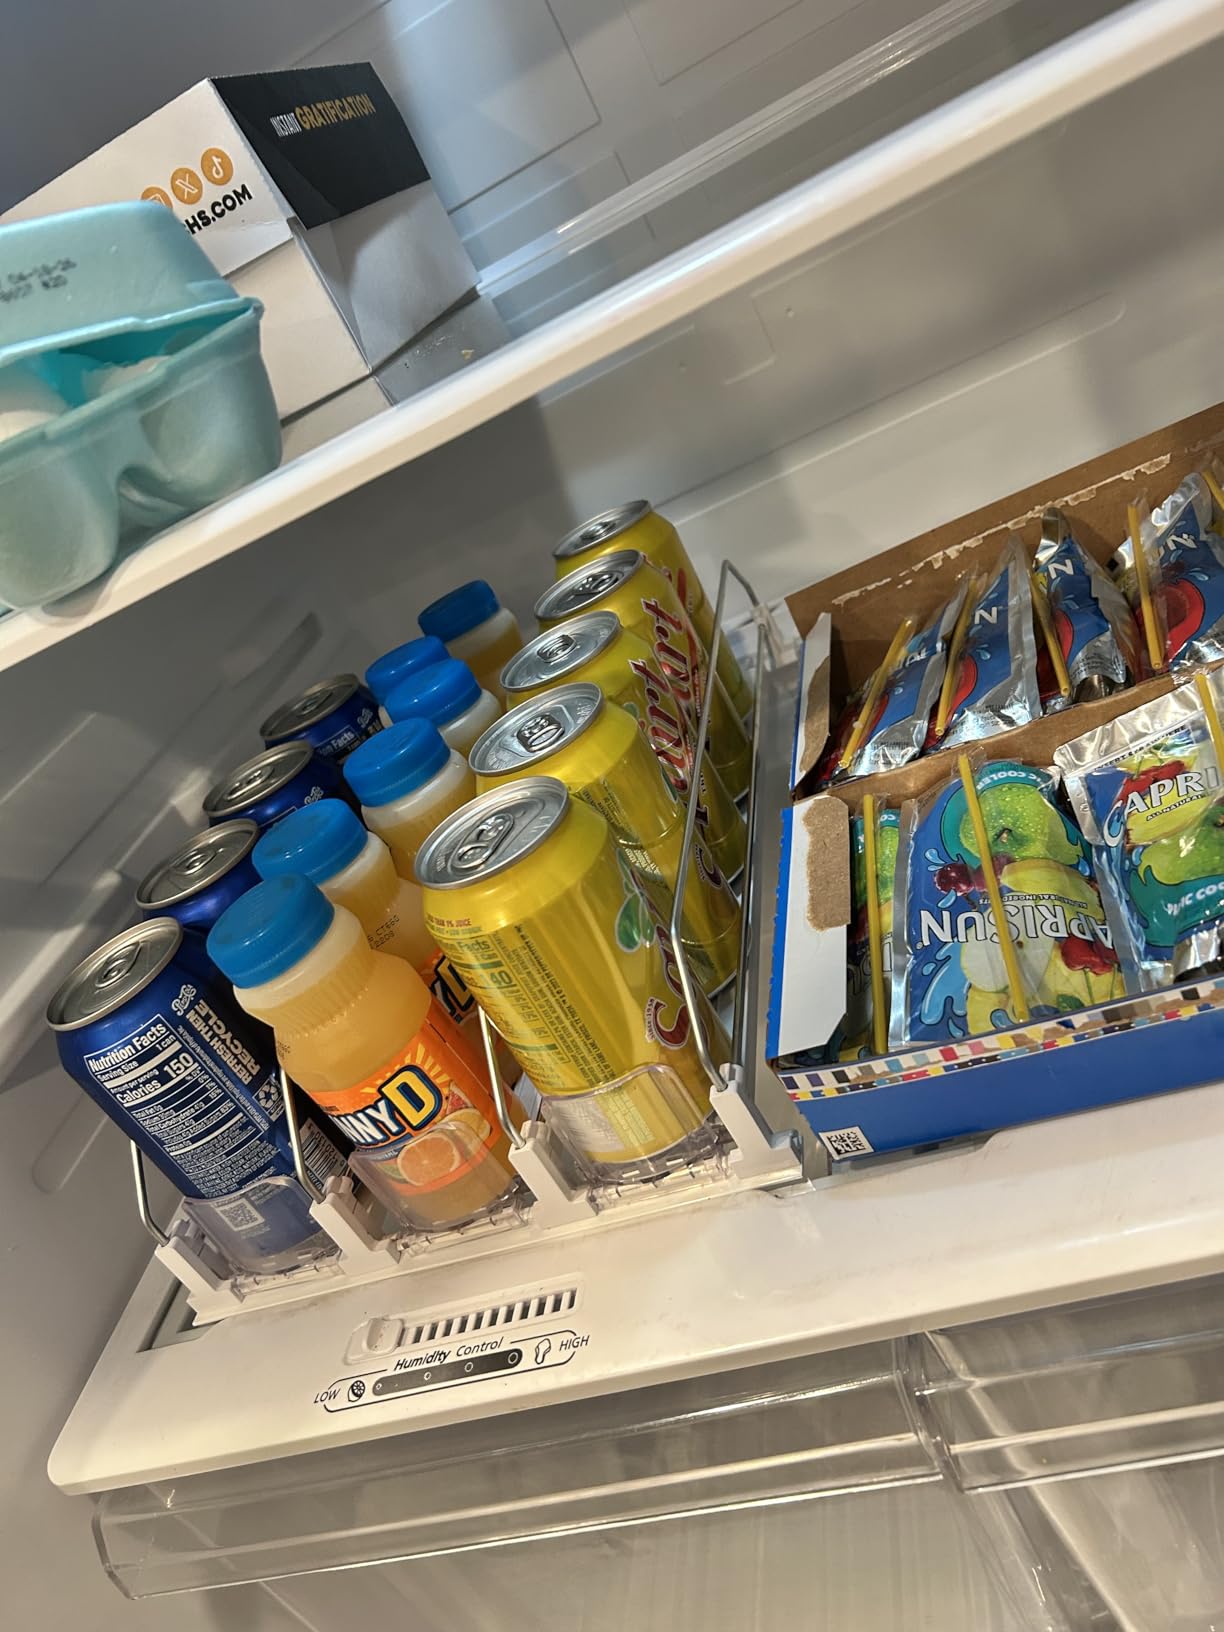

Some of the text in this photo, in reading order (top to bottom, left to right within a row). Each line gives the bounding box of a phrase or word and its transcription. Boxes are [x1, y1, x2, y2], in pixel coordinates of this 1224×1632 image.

[295, 93, 376, 130] GRATIFICATION
[183, 184, 253, 235] HS.COM
[88, 1022, 167, 1073] Nutrition Facts
[184, 1008, 215, 1042] THEN
[194, 999, 262, 1075] RECYCLE
[96, 1066, 124, 1082] Serving
[120, 1058, 139, 1073] Size
[160, 1033, 176, 1048] can
[115, 1051, 194, 1103] Calories 150
[208, 1035, 254, 1084] REFRESH
[393, 1336, 504, 1371] Humidity Control
[558, 1335, 590, 1352] HIGH
[313, 1388, 342, 1404] LOW
